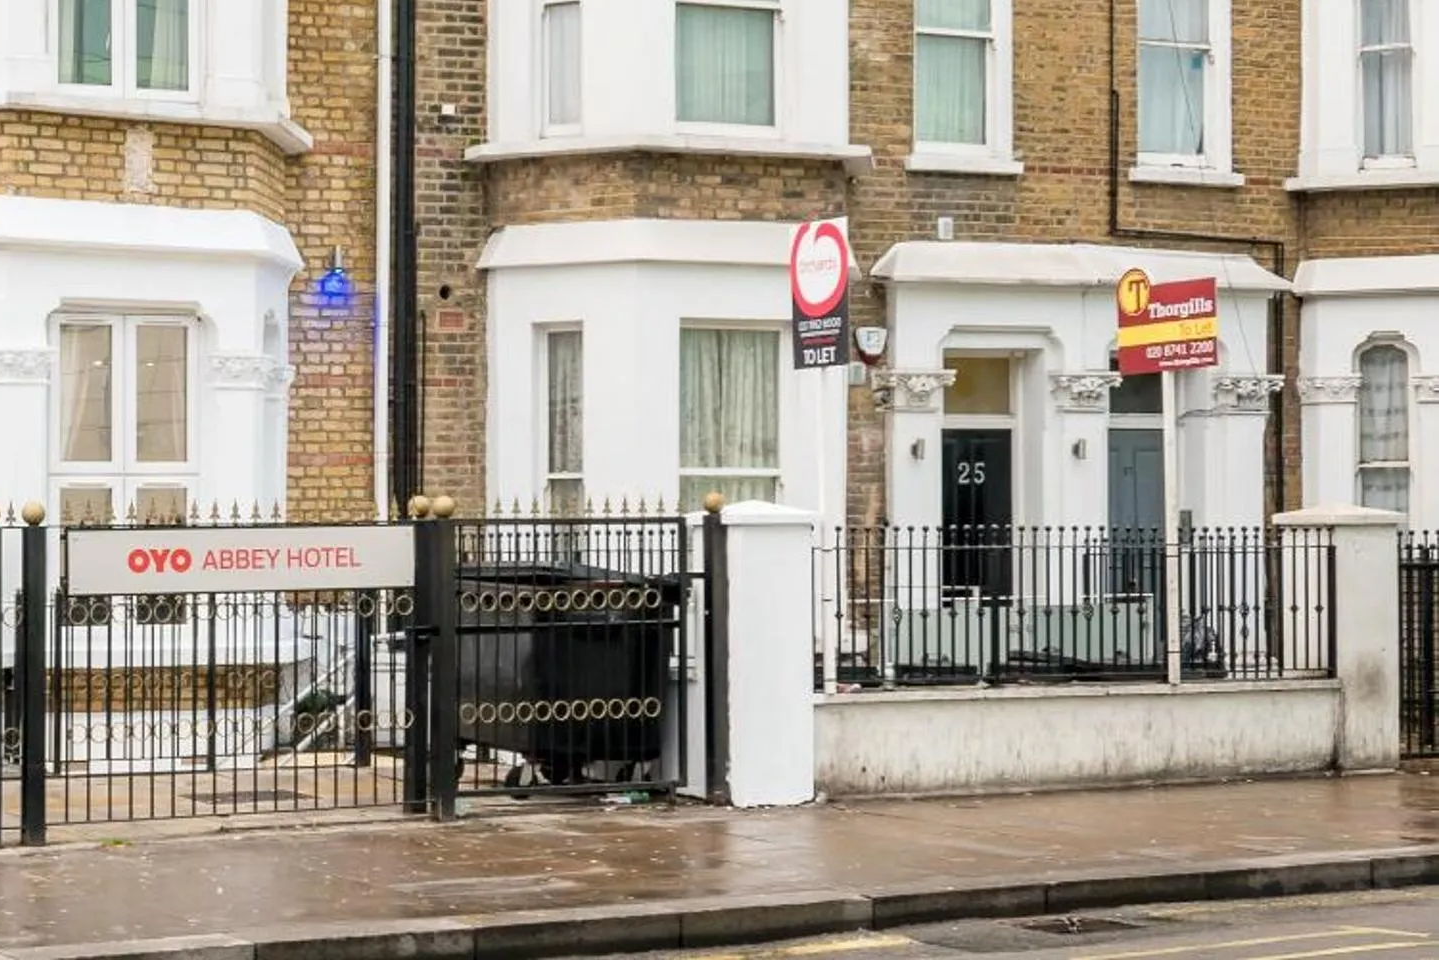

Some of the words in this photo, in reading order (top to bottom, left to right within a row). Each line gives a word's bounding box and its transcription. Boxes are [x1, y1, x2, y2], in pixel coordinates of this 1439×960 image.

[1147, 297, 1214, 318] Thorgills
[803, 349, 816, 365] TO
[817, 346, 837, 364] LET
[958, 462, 985, 484] 25
[127, 548, 192, 573] OYO
[202, 549, 281, 570] ABBEY
[287, 547, 361, 569] HOTEL
